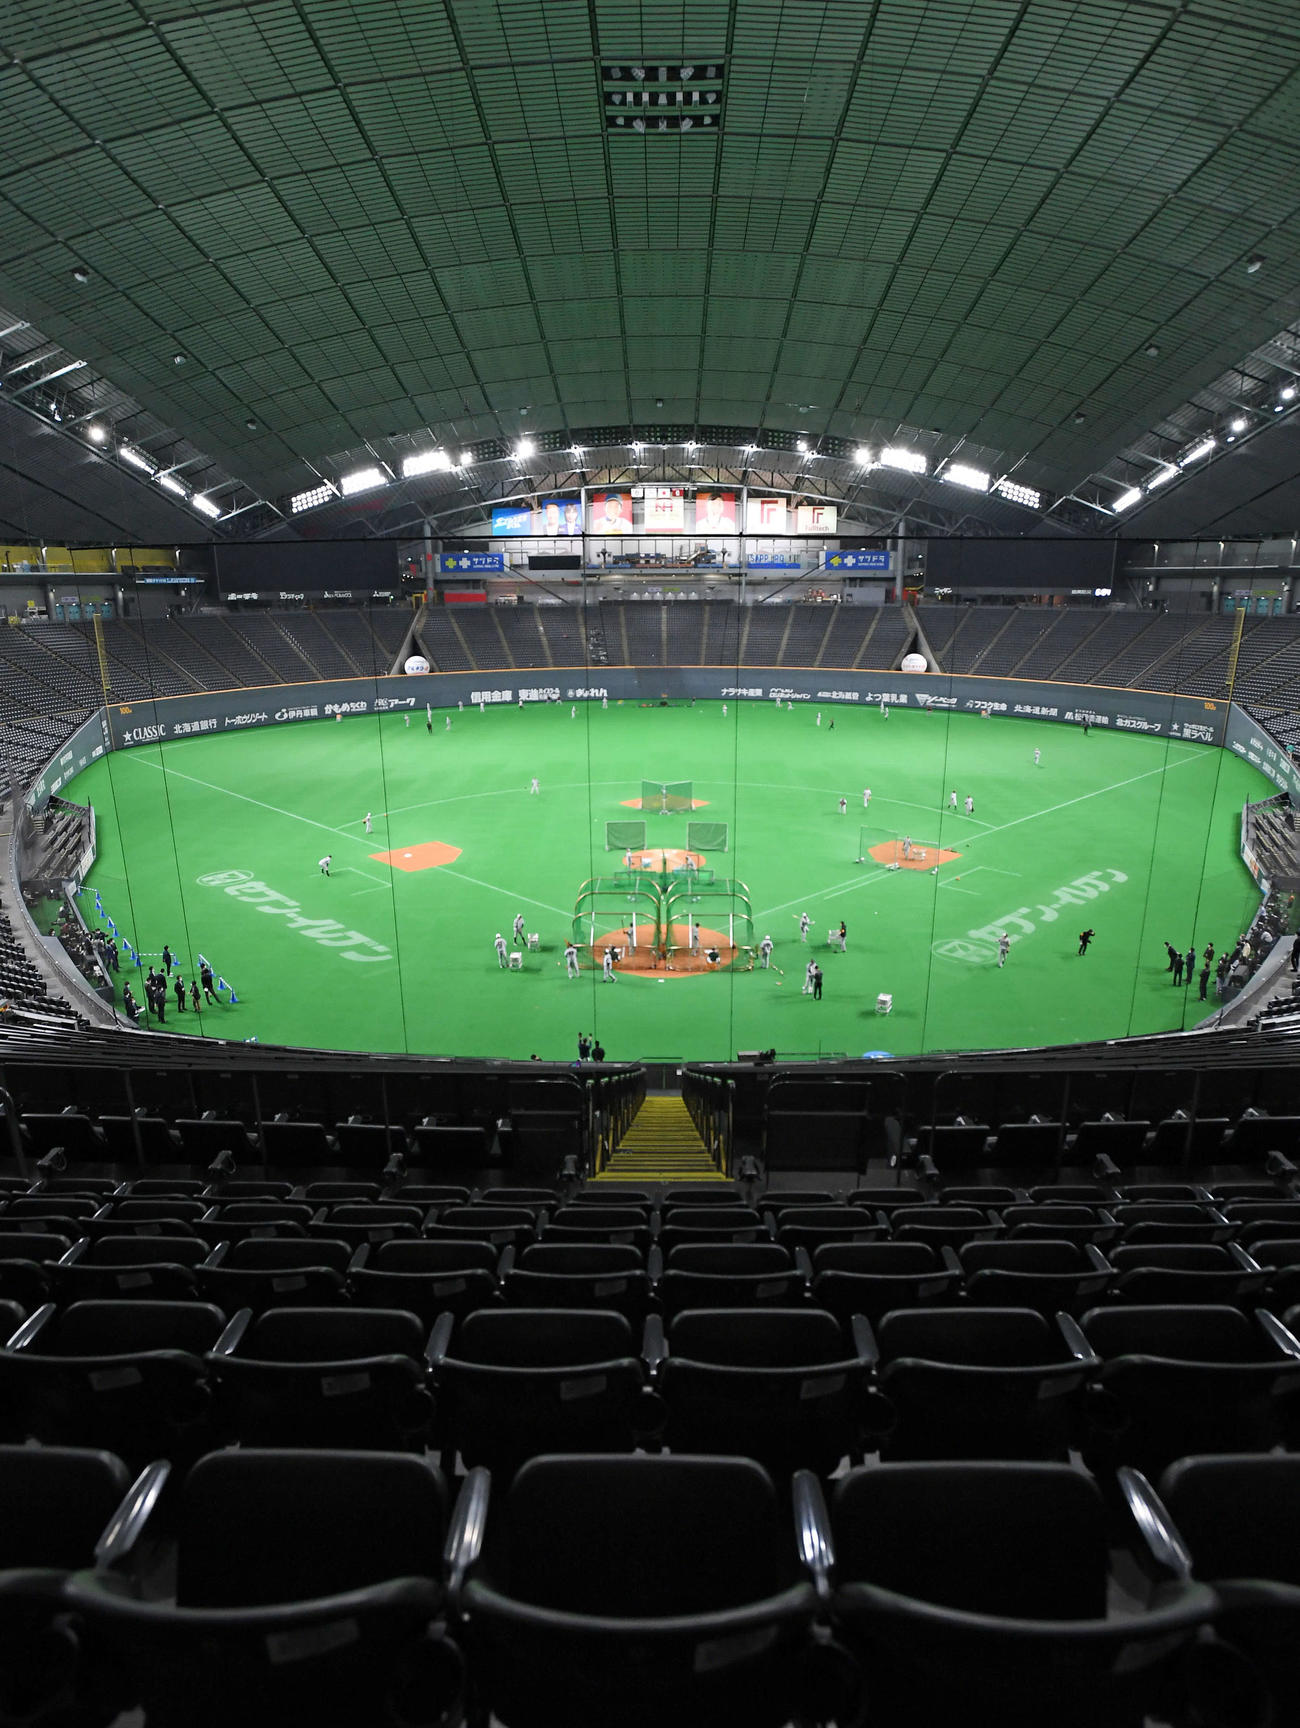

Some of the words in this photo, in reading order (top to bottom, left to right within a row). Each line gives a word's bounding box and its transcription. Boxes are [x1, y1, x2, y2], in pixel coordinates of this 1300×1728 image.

[471, 690, 512, 703] 信用金庫
[518, 688, 539, 700] 東進
[575, 688, 608, 697] ぎょれん
[721, 687, 763, 697] ナラサキ産業
[865, 692, 908, 704] よつ葉乳業
[324, 701, 367, 714] かもめちくわ
[974, 700, 1007, 711] フコク生命
[1013, 704, 1058, 717] 北海道新聞
[224, 712, 268, 726] トーホウリゾート
[1115, 718, 1162, 732] 北ガスグループ
[133, 724, 166, 741] CLASSIC
[173, 718, 217, 734] 北海道銀行
[1182, 728, 1214, 742] 黒ラベル
